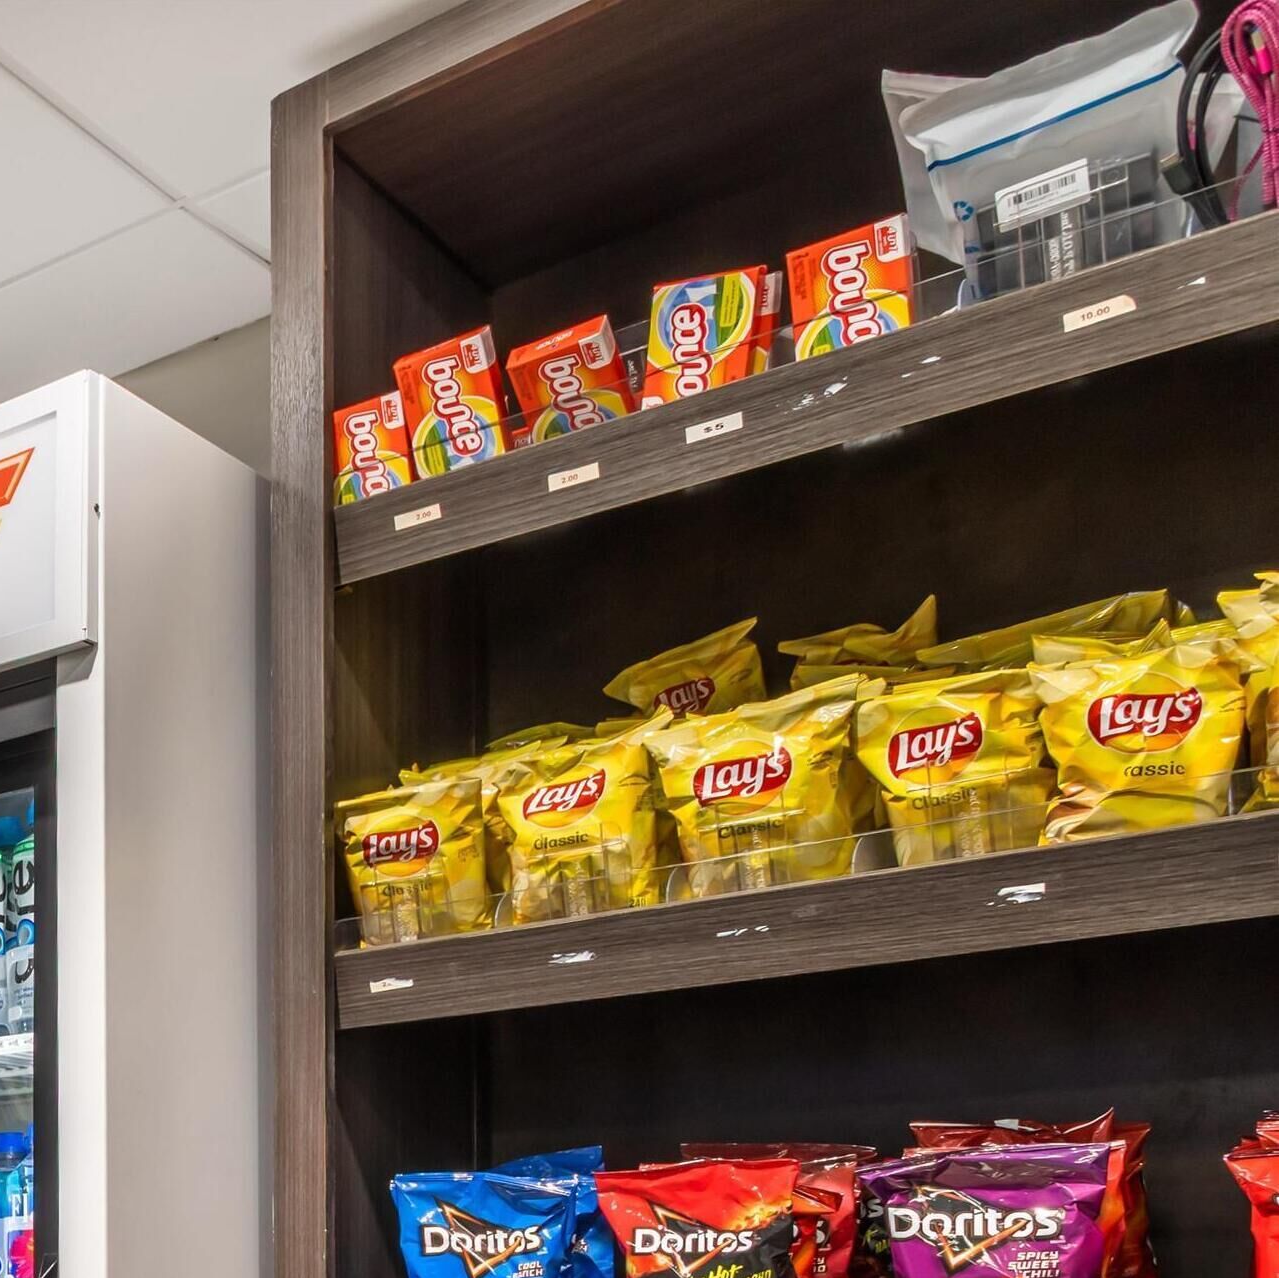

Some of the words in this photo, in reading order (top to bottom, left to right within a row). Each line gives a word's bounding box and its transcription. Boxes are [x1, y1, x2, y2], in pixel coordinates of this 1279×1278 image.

[827, 242, 880, 346] bounc
[1081, 306, 1111, 321] 10.00
[672, 308, 708, 397] ounce
[425, 356, 481, 454] bounce
[346, 410, 391, 496] bounc
[560, 473, 579, 484] 2.00
[1098, 690, 1200, 738] Lay's
[894, 718, 977, 771] Lay's
[528, 771, 603, 815] Lay's
[701, 750, 786, 801] Lay's
[368, 824, 434, 863] Lay's
[423, 1225, 542, 1254] Doritos
[634, 1228, 754, 1254] Doritos
[889, 1206, 1060, 1239] Doritos
[517, 1261, 542, 1271] COOL
[1007, 1259, 1061, 1271] SWEET
[1016, 1250, 1060, 1261] SPICY
